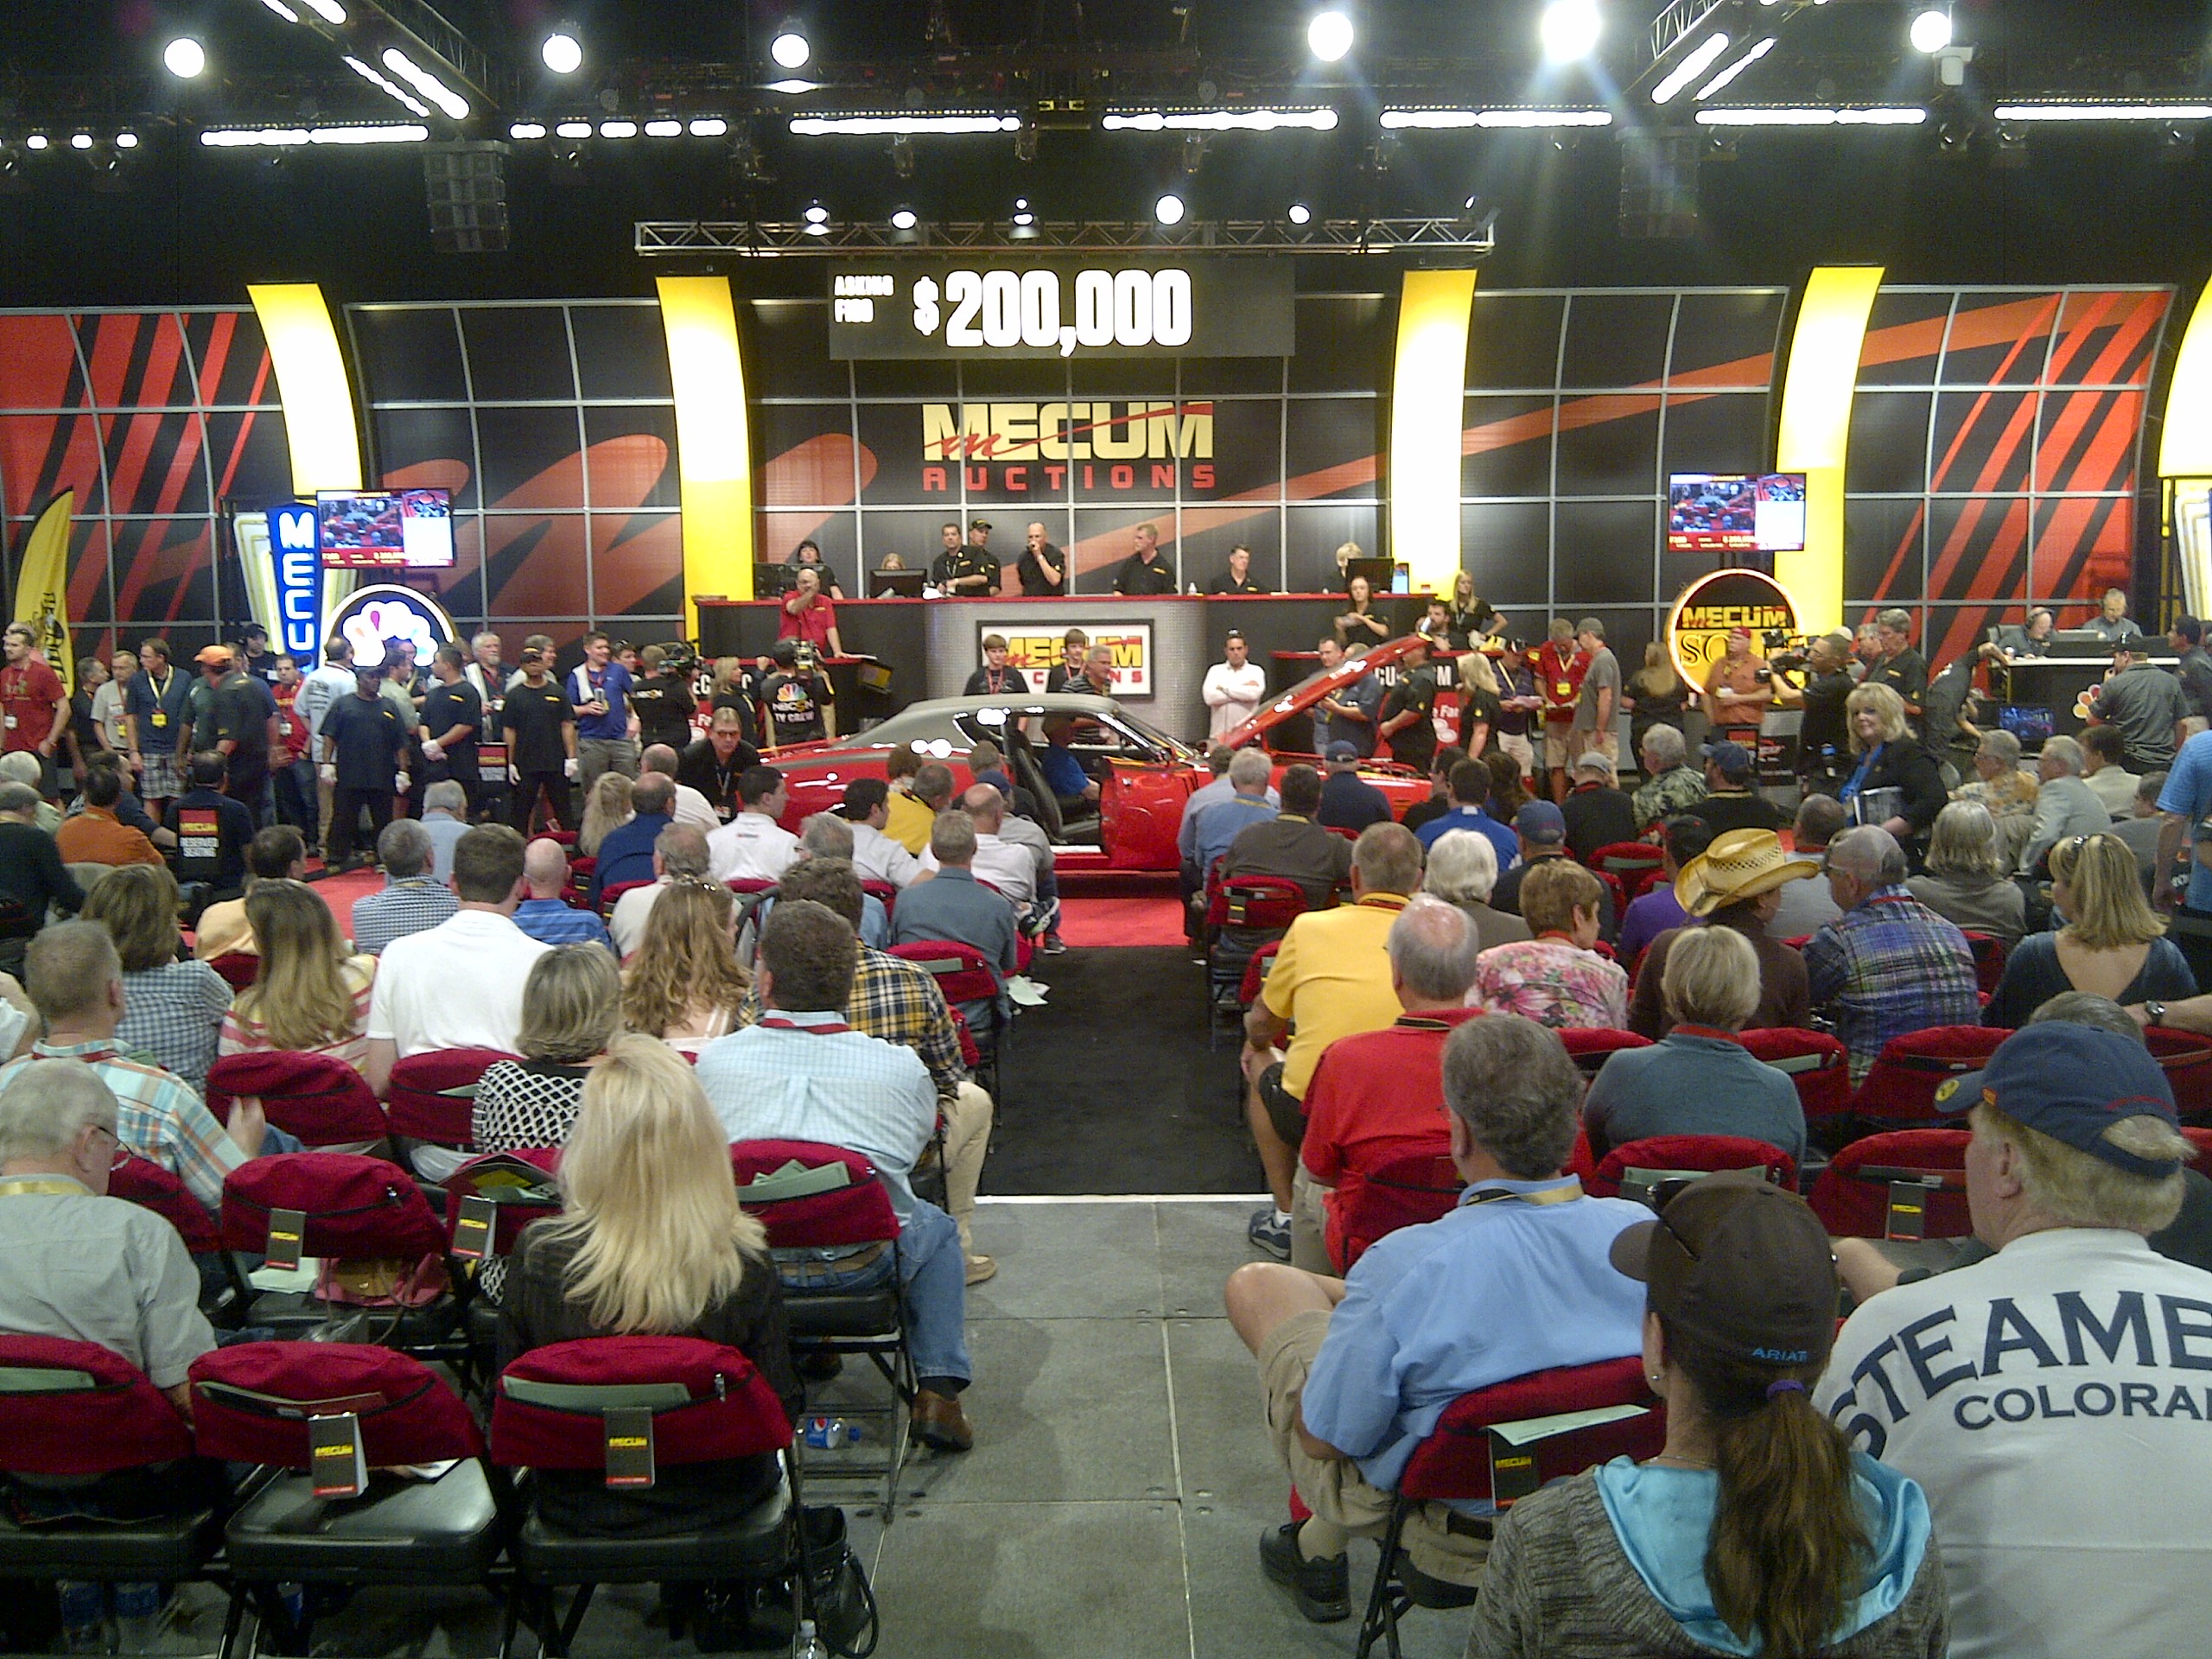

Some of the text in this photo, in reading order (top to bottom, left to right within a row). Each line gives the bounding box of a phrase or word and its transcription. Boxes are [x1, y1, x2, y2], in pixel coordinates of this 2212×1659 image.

[912, 268, 1192, 358] $200,000
[922, 401, 1214, 461] MECUM
[922, 464, 1216, 492] AUCTIONS
[279, 512, 315, 652] MECU
[1681, 606, 1788, 628] MECUM
[1006, 636, 1143, 670] ECM
[1751, 1347, 1808, 1362] ARIAT
[1954, 1382, 2212, 1431] COLORA
[315, 1444, 354, 1458] MECUM
[608, 1436, 648, 1447] MECUM
